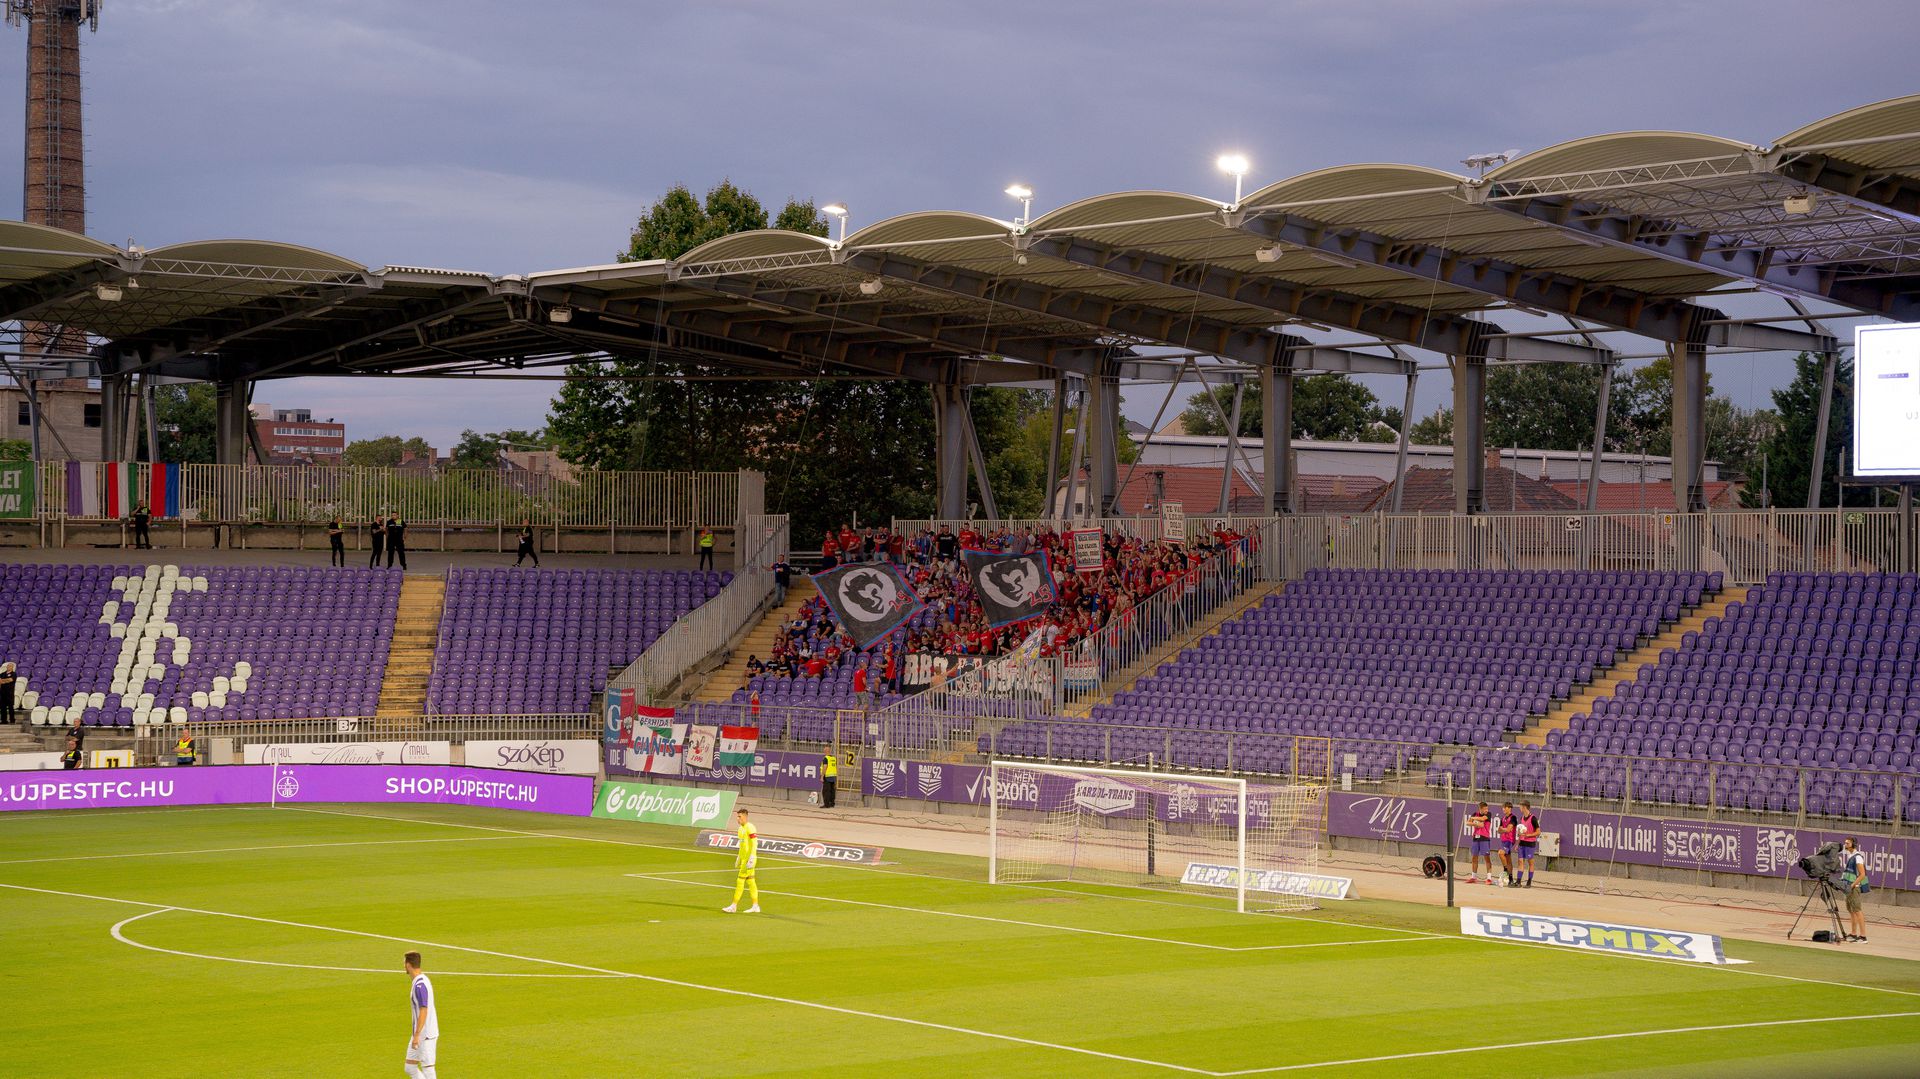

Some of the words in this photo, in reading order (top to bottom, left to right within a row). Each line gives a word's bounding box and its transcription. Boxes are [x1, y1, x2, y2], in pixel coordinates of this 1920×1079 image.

[0, 470, 21, 488] ET
[338, 720, 358, 732] B7
[409, 745, 430, 756] MAUL
[609, 749, 620, 765] IDE
[633, 736, 677, 757] GIANTS
[846, 753, 854, 765] 12
[385, 777, 538, 803] SHOP.UJPESTFC.HU
[983, 775, 1038, 802] Rexona
[626, 789, 693, 818] otpbank
[696, 801, 716, 814] LIGA
[709, 833, 864, 861] 11TAMSPORTS
[1573, 822, 1614, 849] HAJRÁ
[1617, 824, 1657, 852] LILÁK!
[1666, 830, 1738, 862] SECTOR
